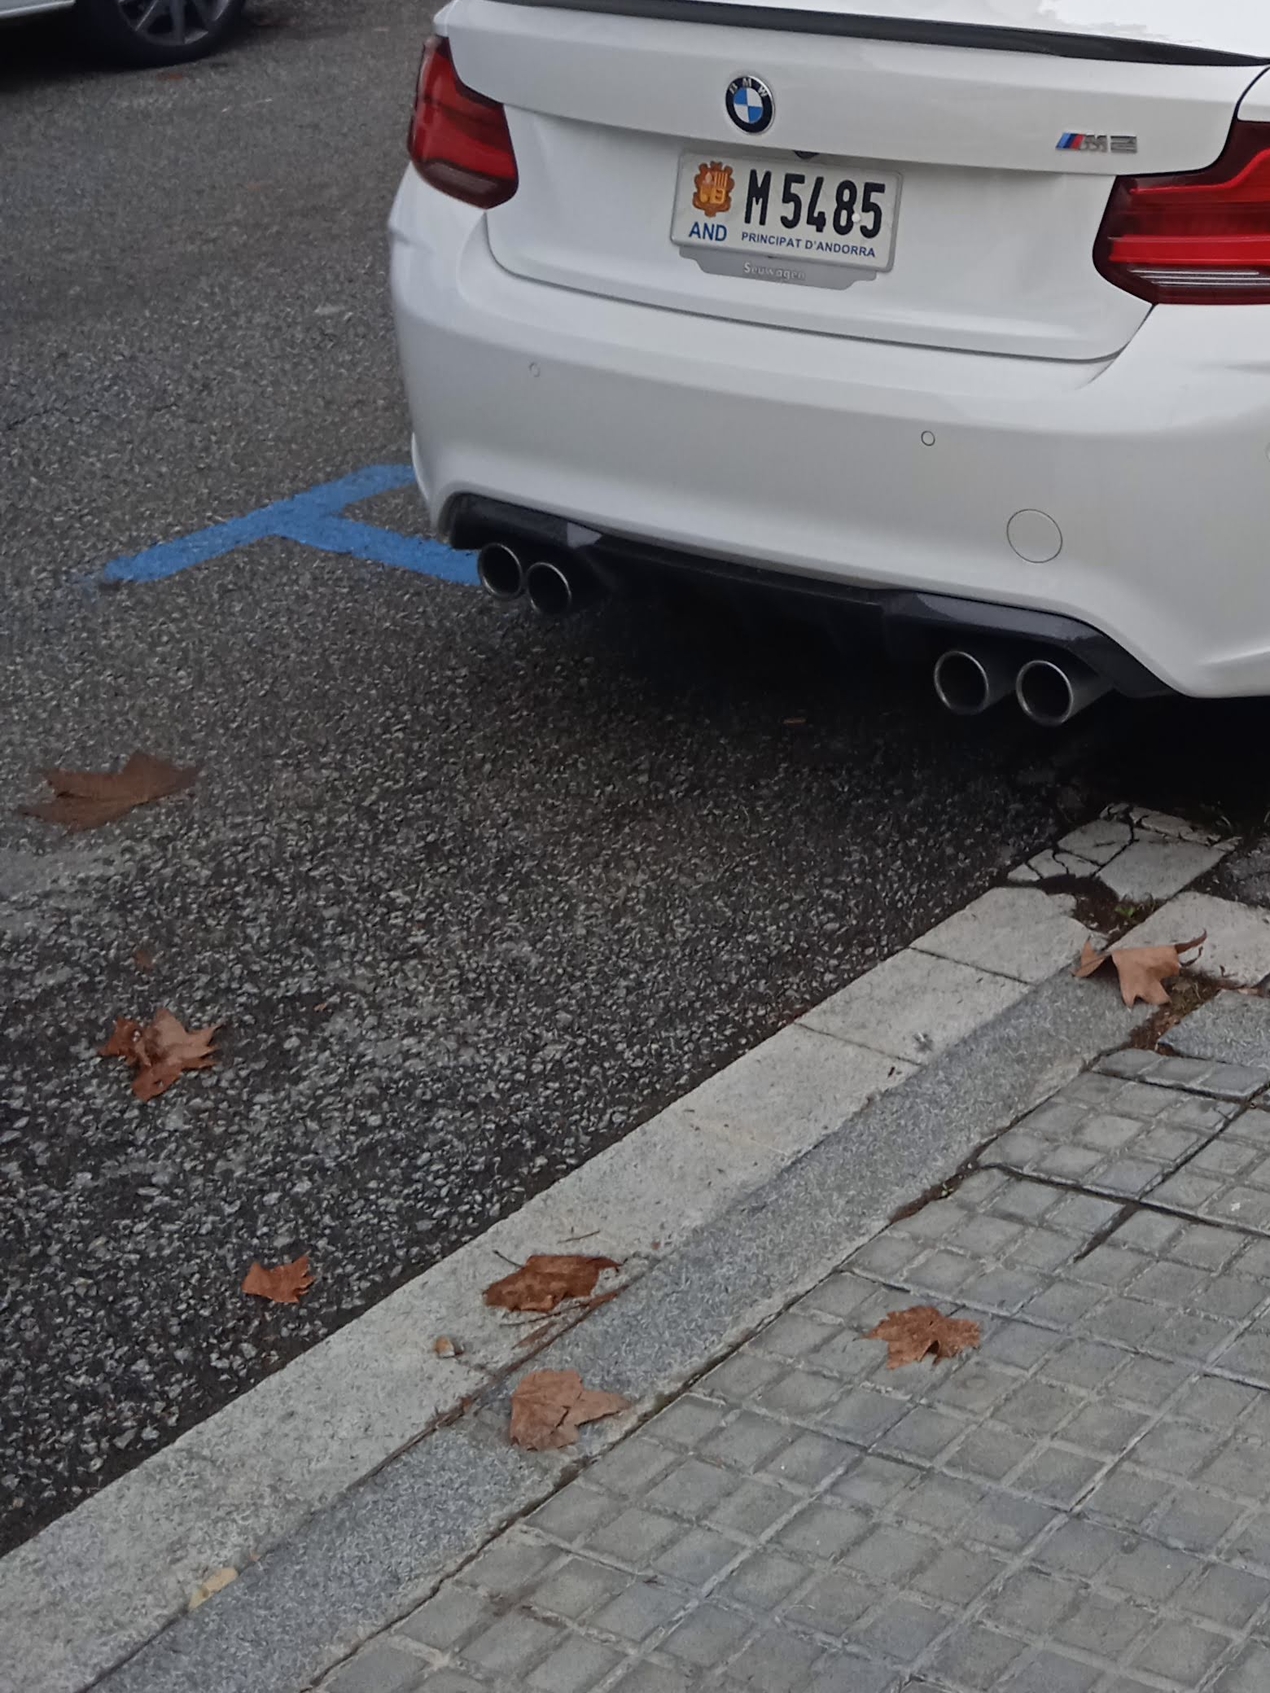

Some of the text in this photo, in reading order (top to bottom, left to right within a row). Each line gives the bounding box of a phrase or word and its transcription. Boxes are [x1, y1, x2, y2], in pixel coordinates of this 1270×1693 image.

[729, 77, 769, 97] BMW
[688, 221, 727, 242] AND
[741, 231, 876, 257] PRINCIPAT D'ANDORRA
